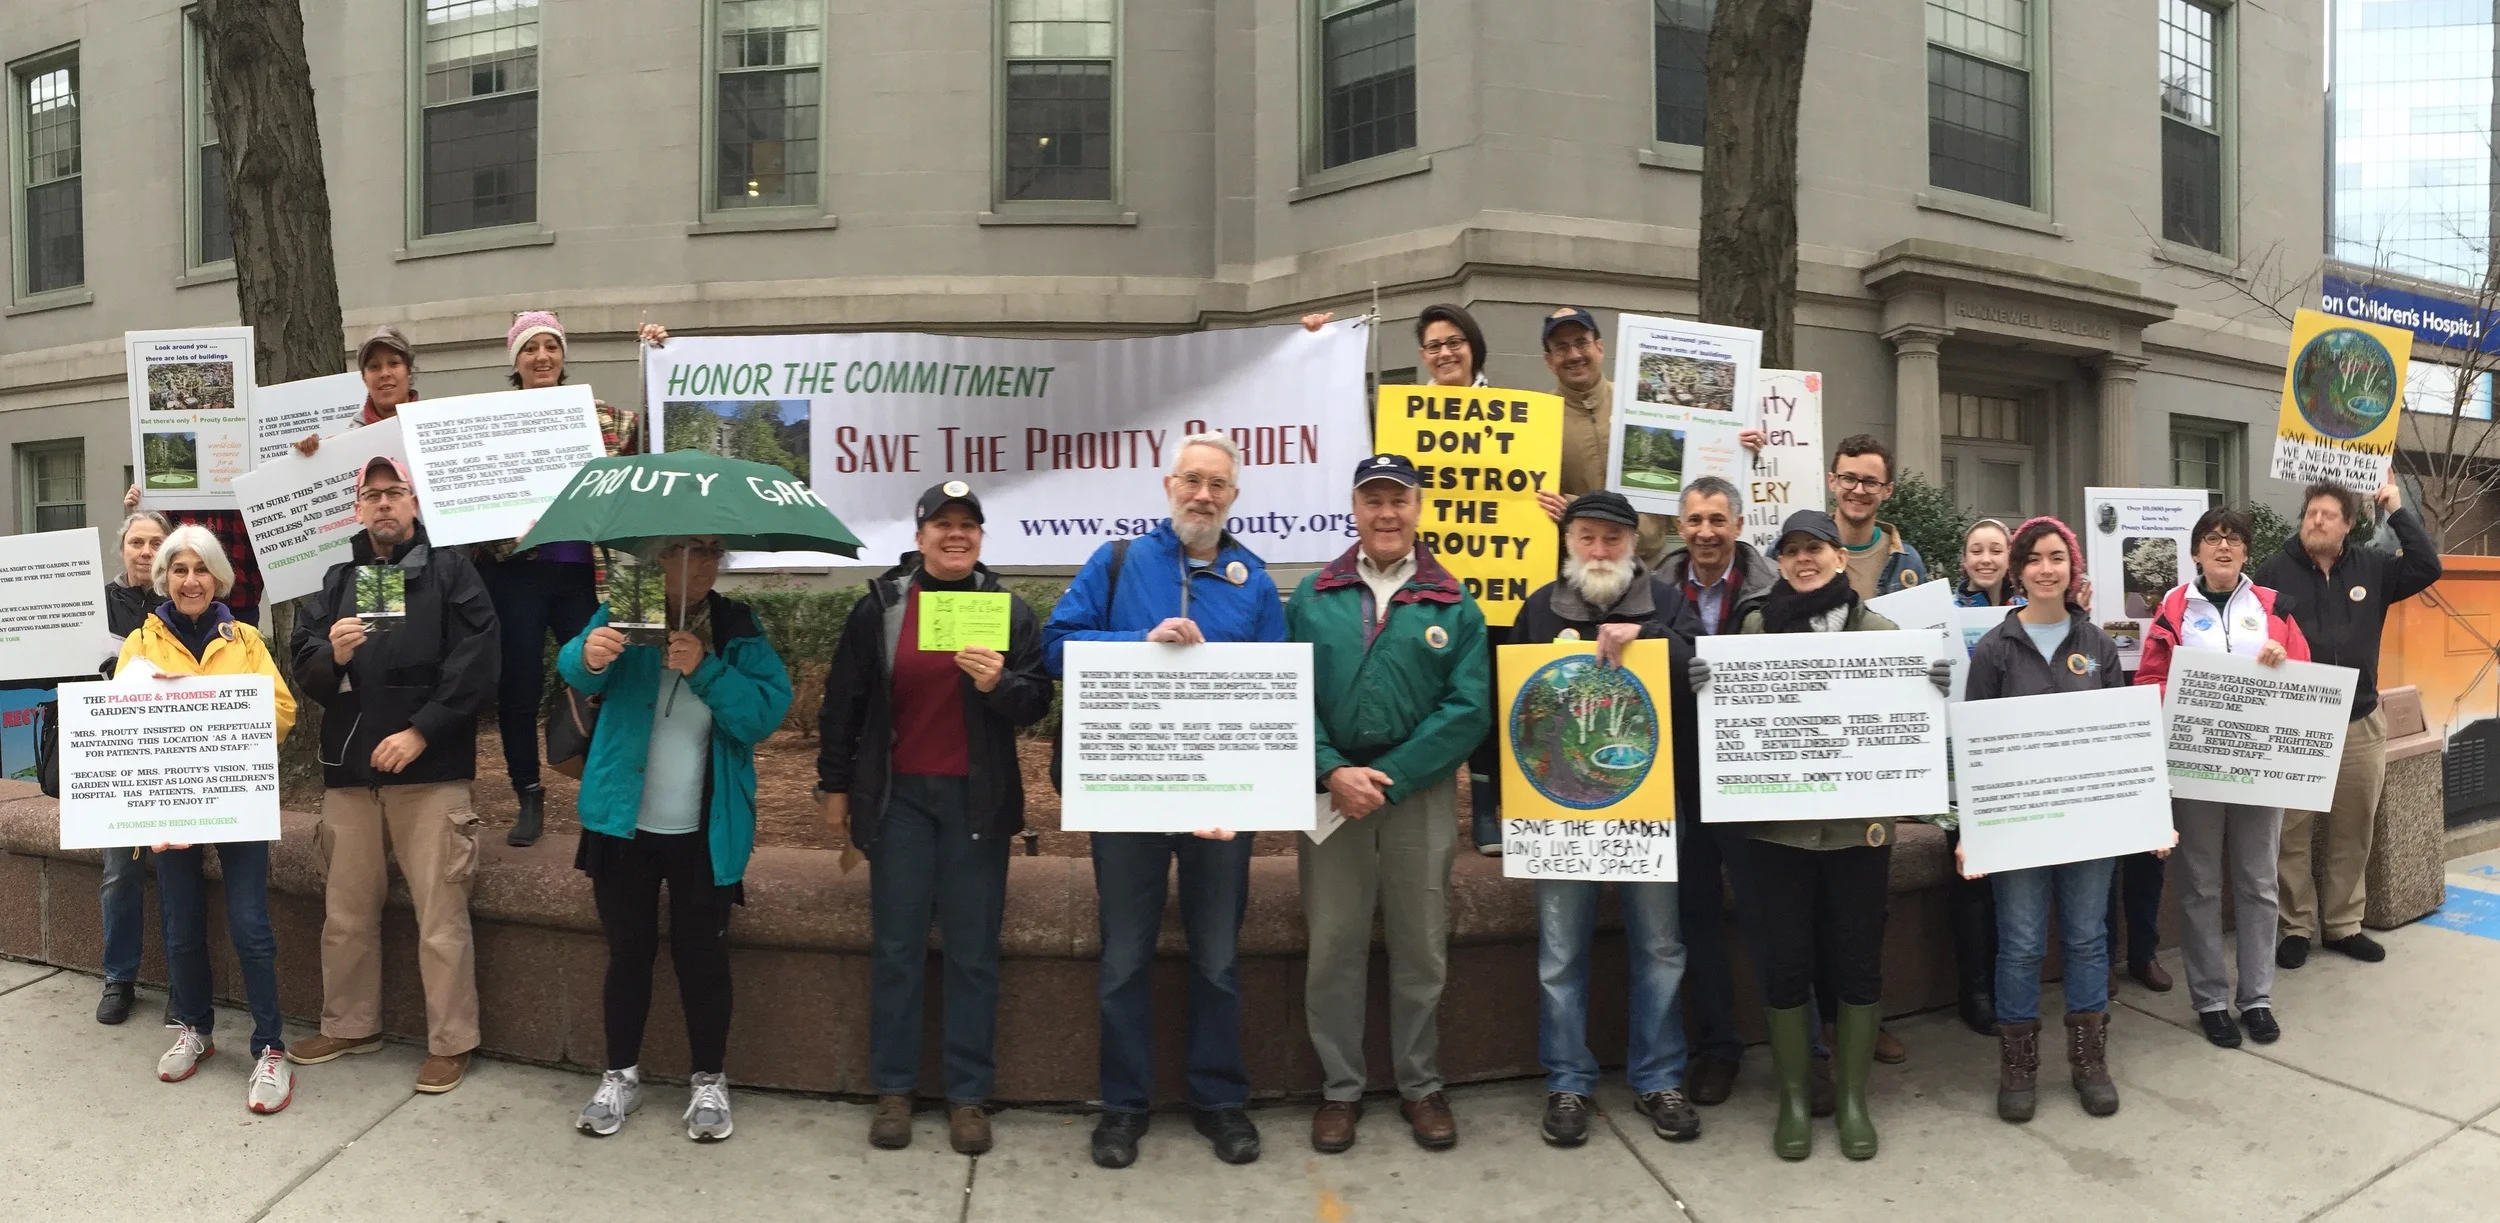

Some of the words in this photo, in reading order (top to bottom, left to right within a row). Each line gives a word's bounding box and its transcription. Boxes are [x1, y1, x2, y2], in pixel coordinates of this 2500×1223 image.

[2347, 296, 2420, 327] Children's
[2423, 310, 2480, 338] Hospital
[668, 363, 772, 396] HONOR
[784, 361, 838, 394] THE
[845, 361, 1056, 398] COMMITMENT
[1407, 396, 1528, 423] PLEASE
[1417, 425, 1514, 454] DON'T
[2283, 446, 2299, 458] WE
[2306, 449, 2335, 464] NEED
[2336, 454, 2350, 466] TO
[2354, 456, 2378, 470] FEEL
[568, 465, 719, 500] PROUTY
[1417, 466, 1547, 491] ESTROY
[2321, 466, 2340, 476] AND
[2345, 468, 2376, 482] TOUCH
[266, 495, 290, 508] SURE
[292, 487, 314, 499] THIS
[251, 512, 286, 527] ESTATE,
[290, 504, 308, 515] BUT
[311, 492, 338, 505] SOME
[1434, 500, 1498, 523] THE
[255, 521, 303, 541] PRICELESS
[303, 512, 322, 522] AND
[260, 543, 278, 555] AND
[279, 539, 294, 548] WE
[1464, 577, 1527, 600] DEN
[83, 696, 106, 704] THE
[108, 694, 152, 703] PLAQUE
[154, 693, 163, 701] &
[166, 690, 216, 700] PROMISE
[218, 690, 233, 698] AT
[234, 688, 258, 697] THE
[2177, 696, 2189, 705] IT
[2190, 699, 2224, 709] SAVED
[2225, 702, 2243, 712] ME.
[90, 706, 146, 716] GARDEN'S
[148, 703, 208, 714] ENTRANCE
[211, 701, 250, 711] READS:
[101, 728, 139, 736] PROUTY
[143, 726, 186, 734] INSISTED
[207, 722, 272, 731] PERPETUALLY
[70, 738, 134, 748] MAINTAINING
[163, 735, 208, 744] LOCATION
[241, 732, 272, 740] HAVEN
[107, 748, 152, 757] PATIENTS,
[154, 746, 197, 754] PARENTS
[164, 766, 210, 775] PROUTY'S
[71, 781, 110, 789] GARDEN
[219, 773, 275, 783] CHILDREN'S
[72, 791, 116, 800] HOSPITAL
[149, 788, 195, 796] PATIENTS,
[202, 785, 248, 794] FAMILIES,
[127, 800, 157, 808] STAFF
[173, 797, 203, 805] ENJOY
[1510, 819, 1556, 836] SAVE
[1560, 820, 1596, 836] THE
[1604, 819, 1671, 838] GARDEN
[1506, 840, 1541, 858] LONG
[1550, 840, 1584, 857] LIVE
[1589, 839, 1650, 858] URBAN
[1526, 859, 1592, 874] GREEN
